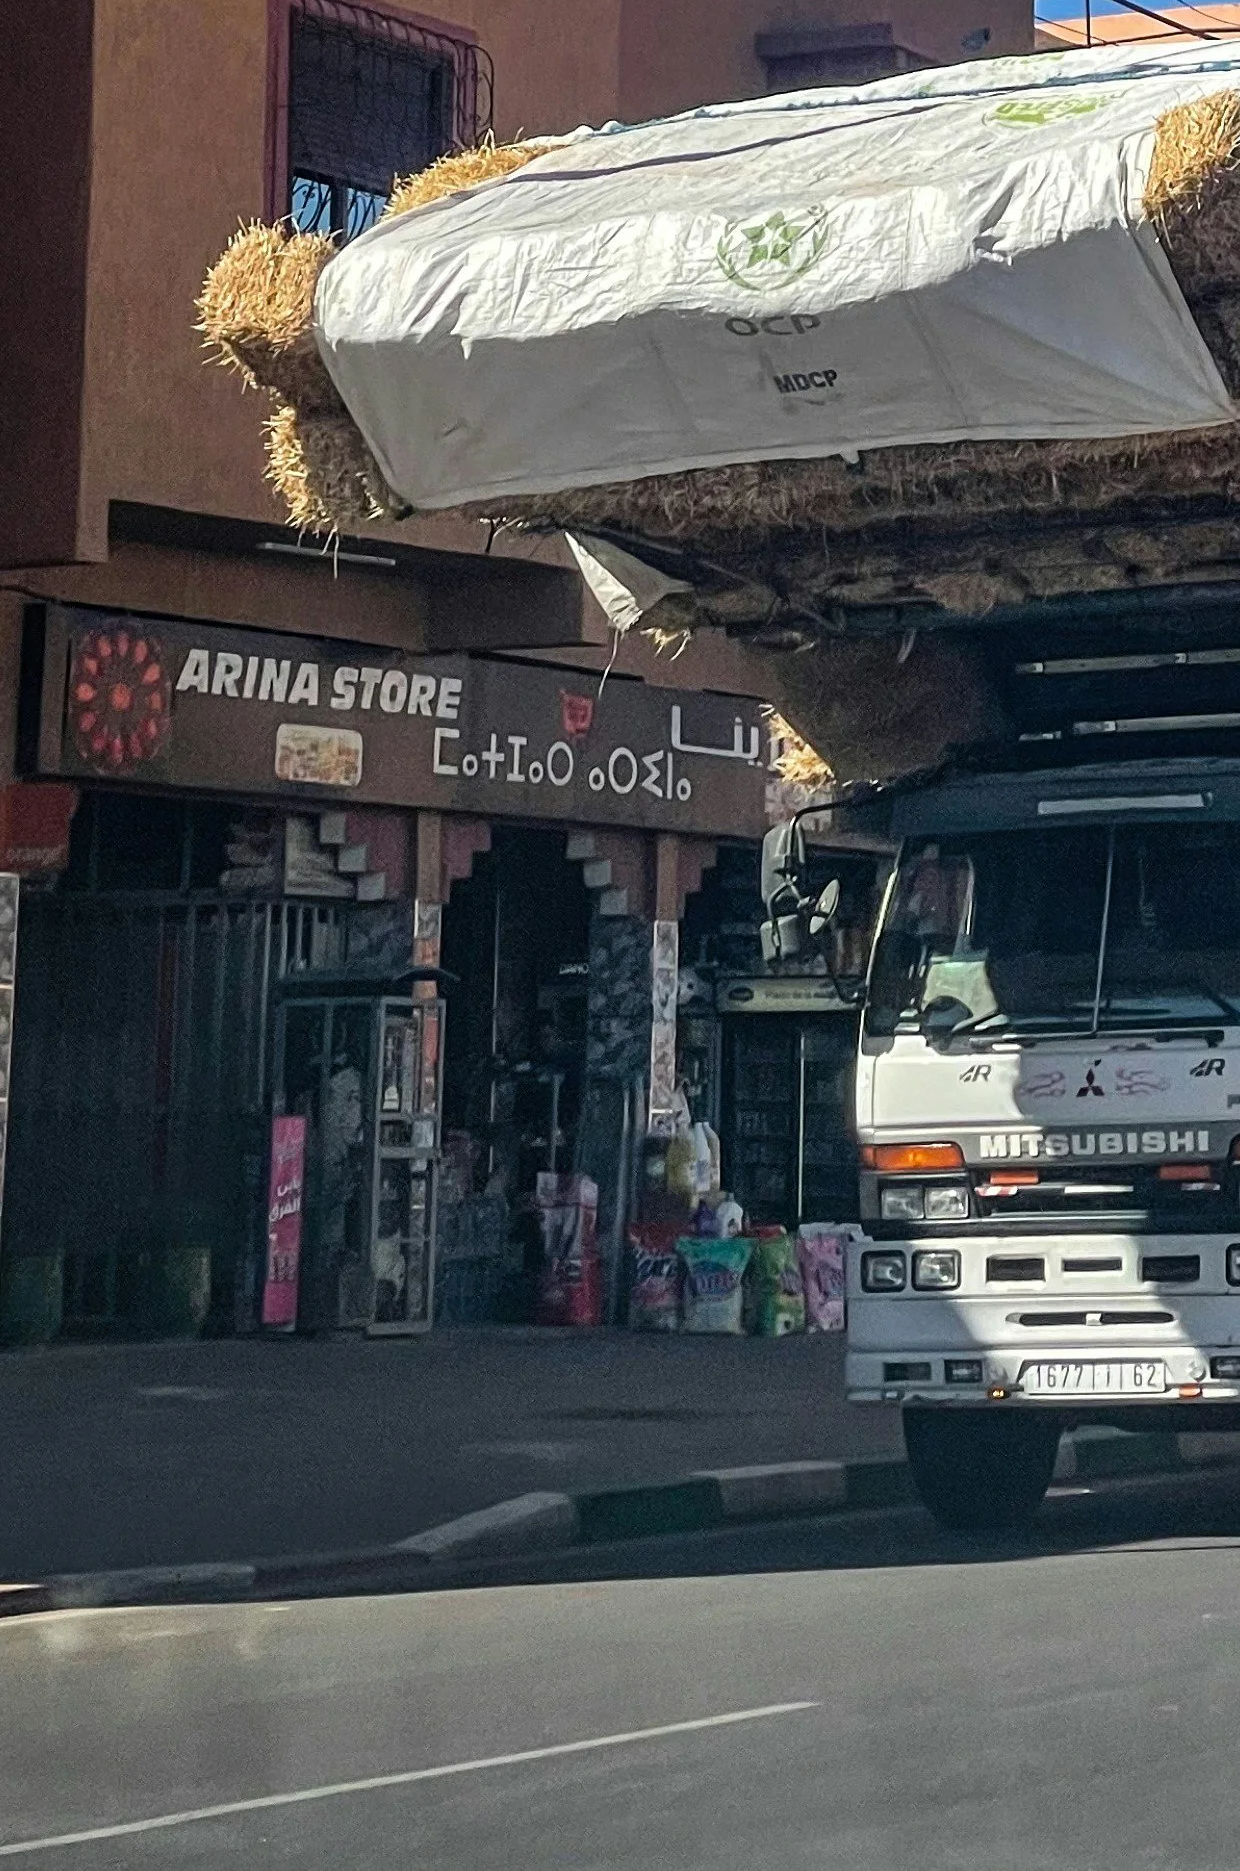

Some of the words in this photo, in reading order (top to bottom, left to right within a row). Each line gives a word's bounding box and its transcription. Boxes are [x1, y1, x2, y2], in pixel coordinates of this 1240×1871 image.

[725, 313, 821, 336] OCP
[773, 369, 838, 394] MDCP
[175, 648, 320, 707] ARINA
[330, 666, 463, 720] STORE
[672, 704, 782, 772] رينا
[979, 1131, 1210, 1159] MITSUBISHI
[1036, 1363, 1084, 1388] 1677
[1133, 1363, 1157, 1388] 62
